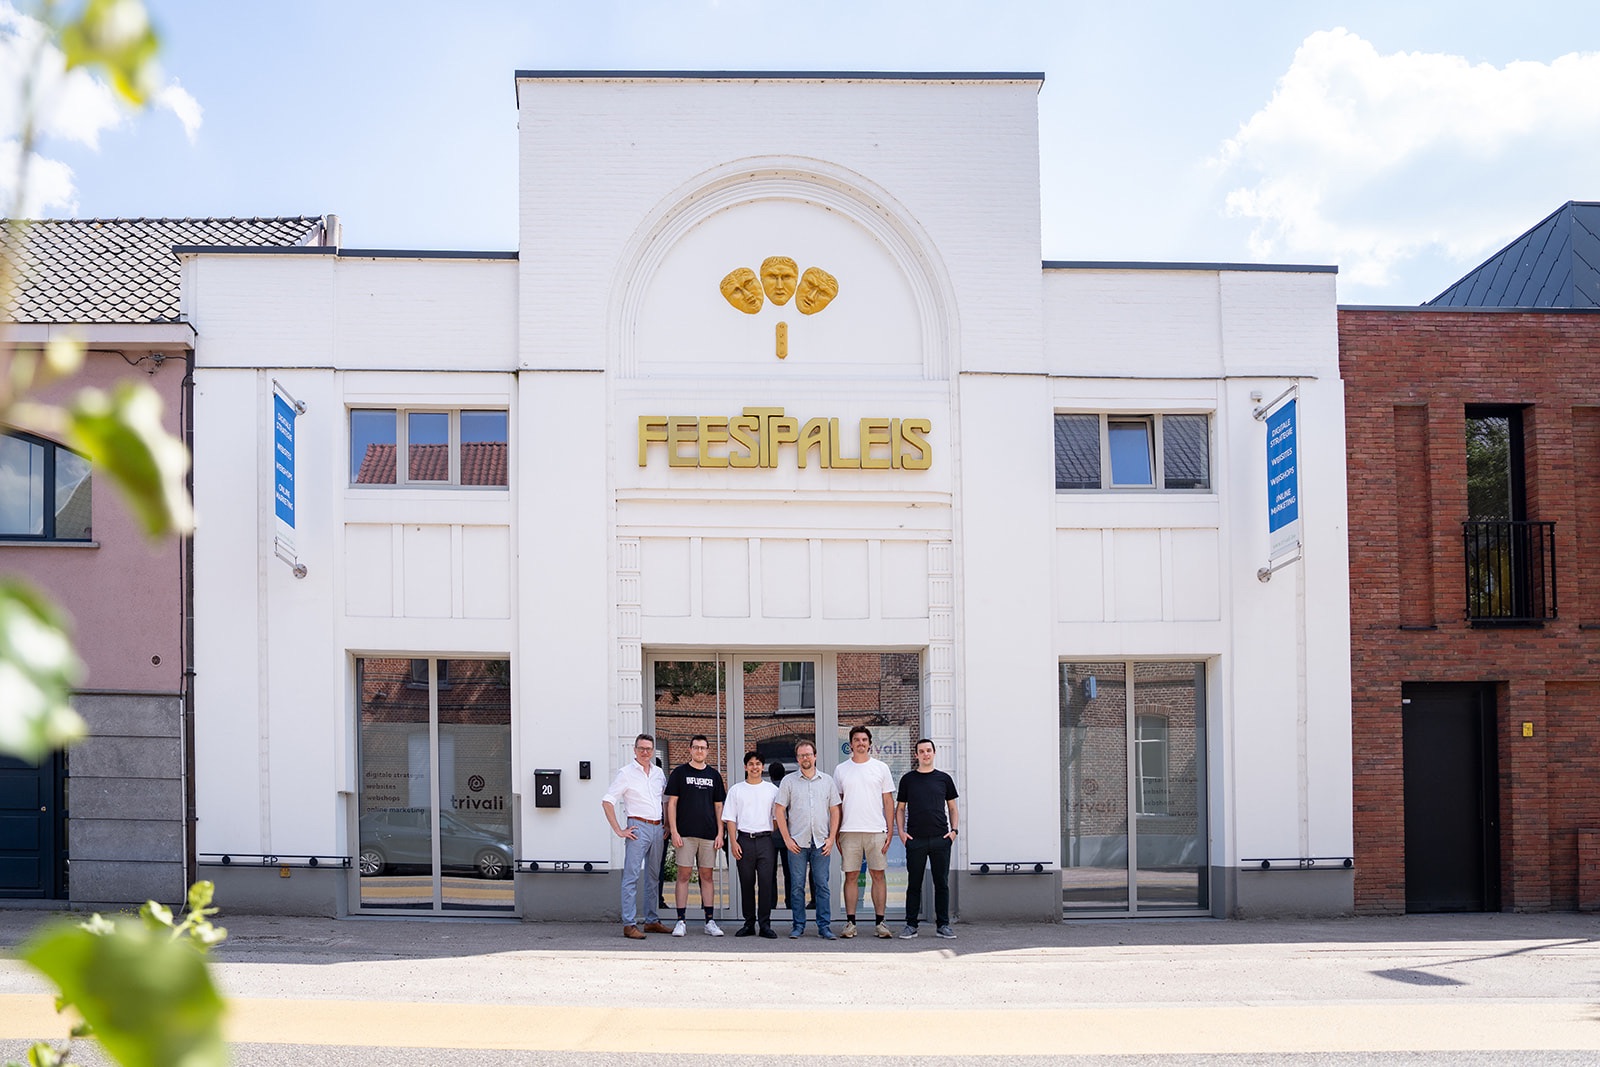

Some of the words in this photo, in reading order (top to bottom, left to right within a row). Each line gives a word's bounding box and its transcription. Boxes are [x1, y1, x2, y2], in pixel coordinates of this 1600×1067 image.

[1271, 417, 1291, 437] DIGITALE
[638, 406, 932, 470] FEESTPALEIS
[1270, 426, 1294, 448] STRATEGIE
[1271, 447, 1293, 466] WEBSITES
[1270, 465, 1295, 486] WEBSHOPS
[1275, 487, 1292, 503] ONLINE
[1270, 495, 1296, 516] MARKETING
[366, 771, 392, 779] digitale
[542, 784, 553, 795] 20
[389, 807, 425, 815] marketing
[450, 795, 503, 810] trivali
